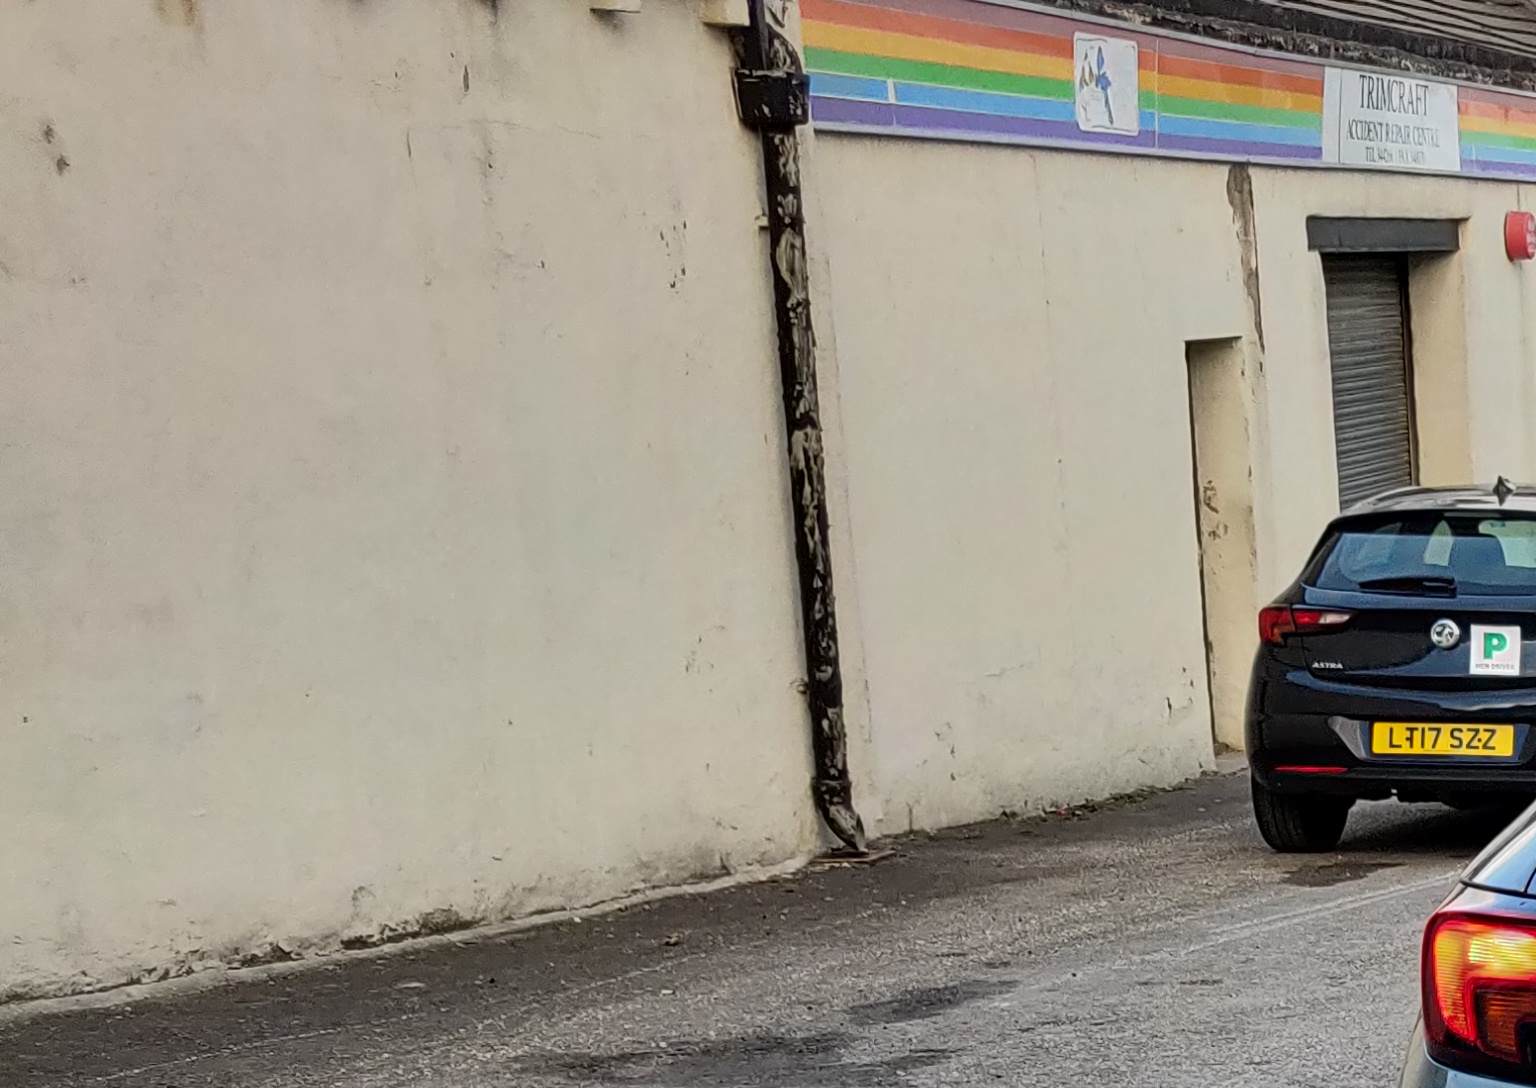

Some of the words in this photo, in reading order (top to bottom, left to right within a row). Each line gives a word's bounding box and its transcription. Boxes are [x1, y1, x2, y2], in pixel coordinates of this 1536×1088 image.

[1359, 74, 1429, 116] TRIMCRAFT
[1347, 118, 1383, 143] ACCIDENT
[1385, 122, 1412, 146] REPAIR
[1412, 125, 1440, 149] CENTRE
[1483, 632, 1508, 660] P
[1312, 661, 1344, 670] ASTRA
[1388, 726, 1442, 750] LT17
[1449, 727, 1497, 751] SZZ
